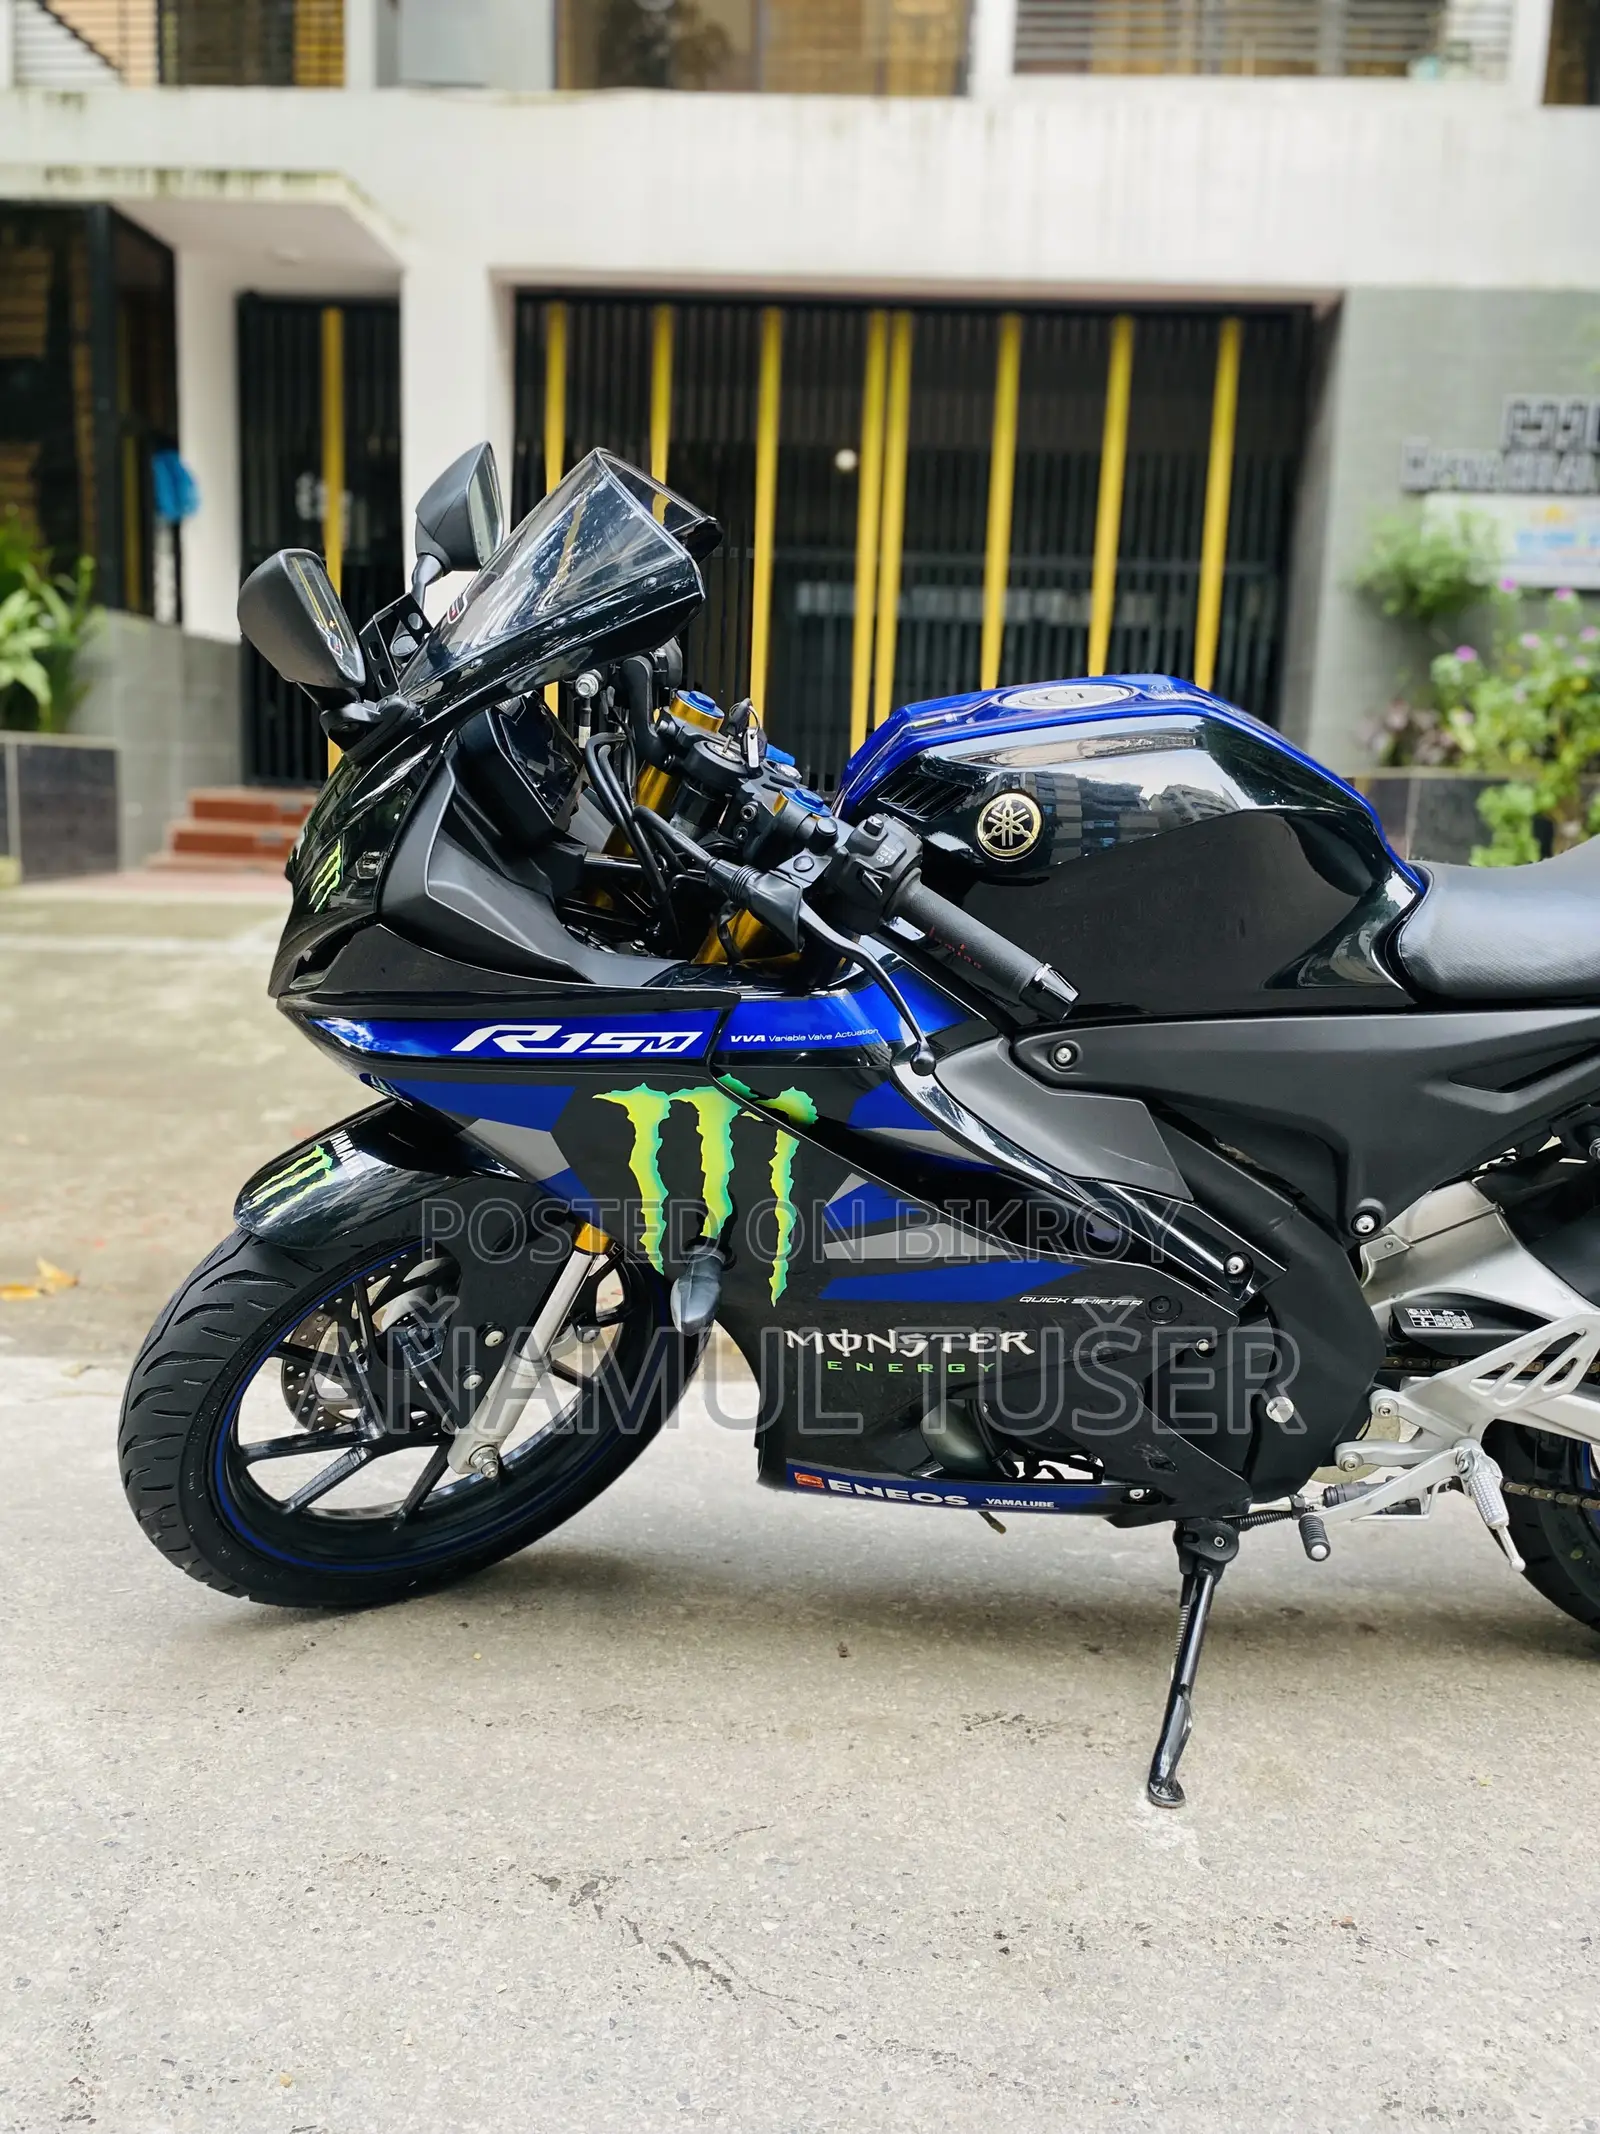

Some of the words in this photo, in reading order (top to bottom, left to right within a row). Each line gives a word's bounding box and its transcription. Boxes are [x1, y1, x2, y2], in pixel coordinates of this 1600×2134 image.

[730, 1034, 766, 1043] VVA
[768, 1033, 806, 1042] Variable
[807, 1032, 833, 1041] Valve
[834, 1028, 879, 1039] Actuation
[1019, 1296, 1069, 1304] QUICK
[826, 1360, 995, 1373] ENERGY
[827, 1479, 969, 1506] ENEOS
[985, 1498, 1055, 1508] YAMALUBE
